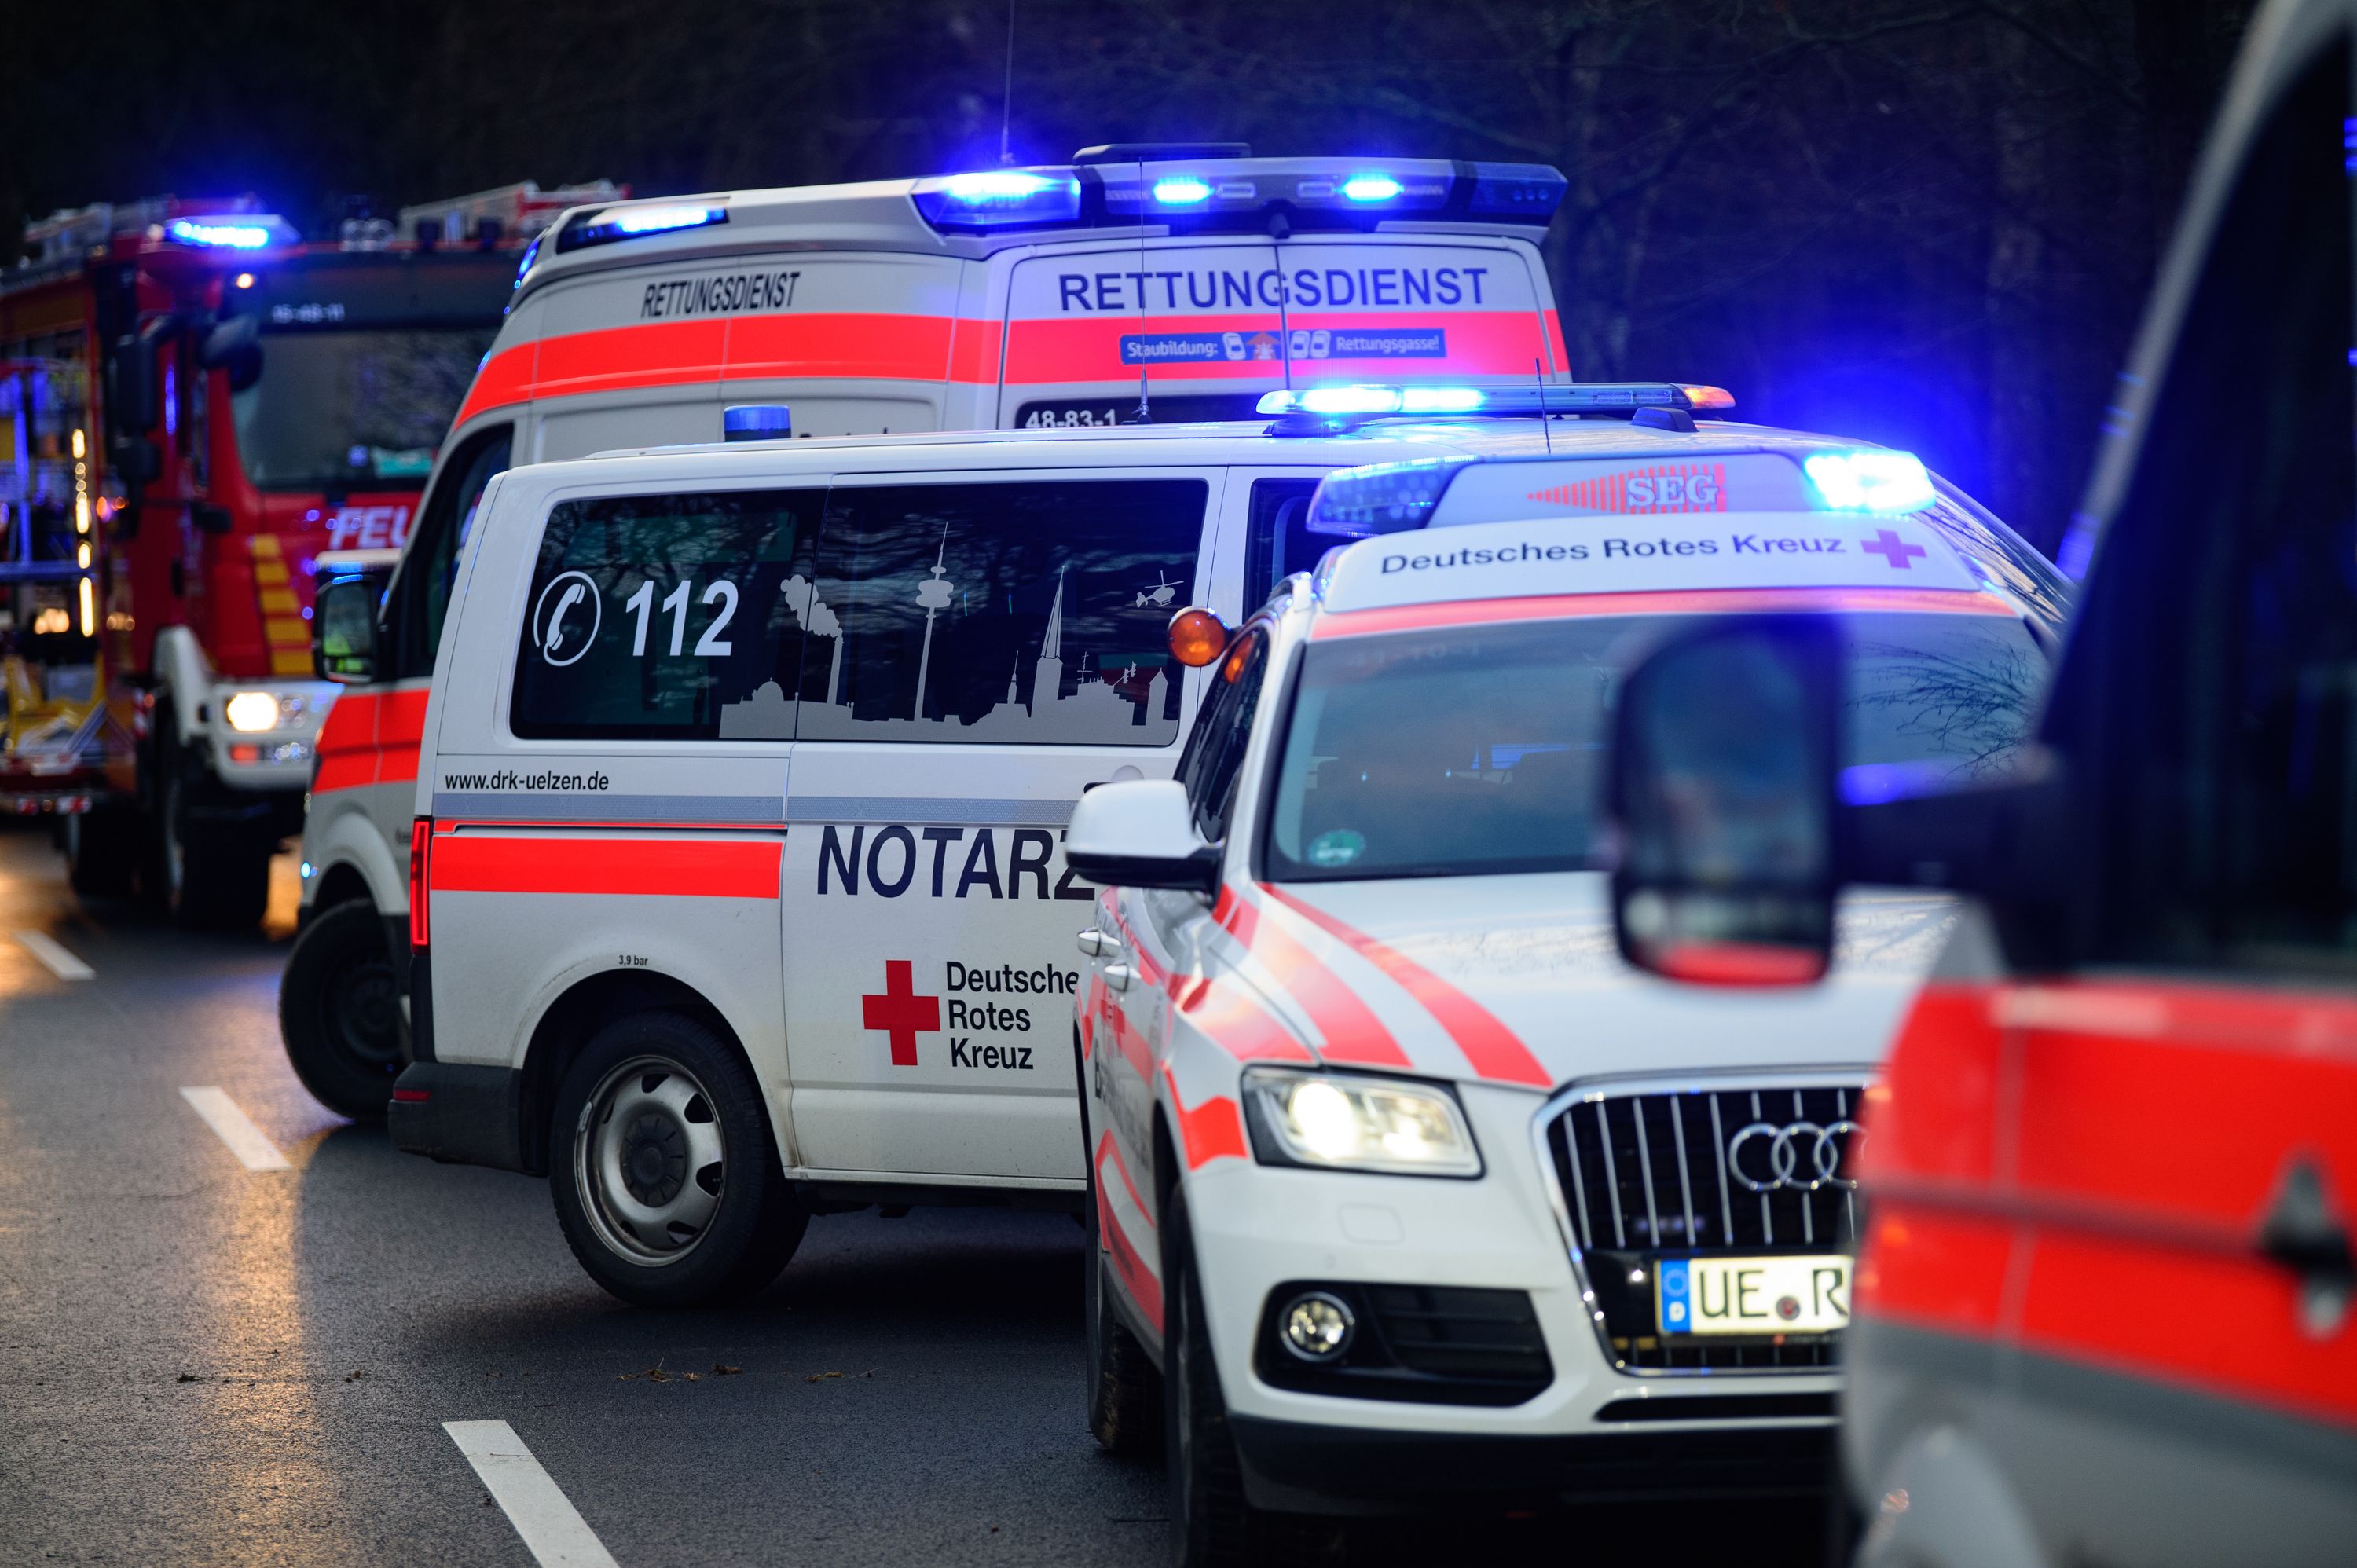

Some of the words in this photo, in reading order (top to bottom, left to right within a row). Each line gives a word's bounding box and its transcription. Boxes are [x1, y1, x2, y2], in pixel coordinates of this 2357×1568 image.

[640, 271, 801, 317] RETTUNGSDIENST
[1059, 268, 1489, 311] RETTUNGSDIENST
[1127, 340, 1219, 357] Staubildung:
[1336, 335, 1439, 353] Rettungsgasse!
[1626, 473, 1720, 508] SEG
[1380, 537, 1589, 575] Deutsches
[1603, 533, 1719, 559] Rotes
[1732, 533, 1847, 555] Kreuz
[625, 580, 739, 657] 112
[445, 770, 609, 790] www.drk-uelzen.de
[618, 954, 632, 966] 3,9
[633, 955, 649, 966] bar
[948, 999, 1032, 1031] Rotes
[950, 1037, 1034, 1070] Kreuz
[1699, 1269, 1768, 1318] UE
